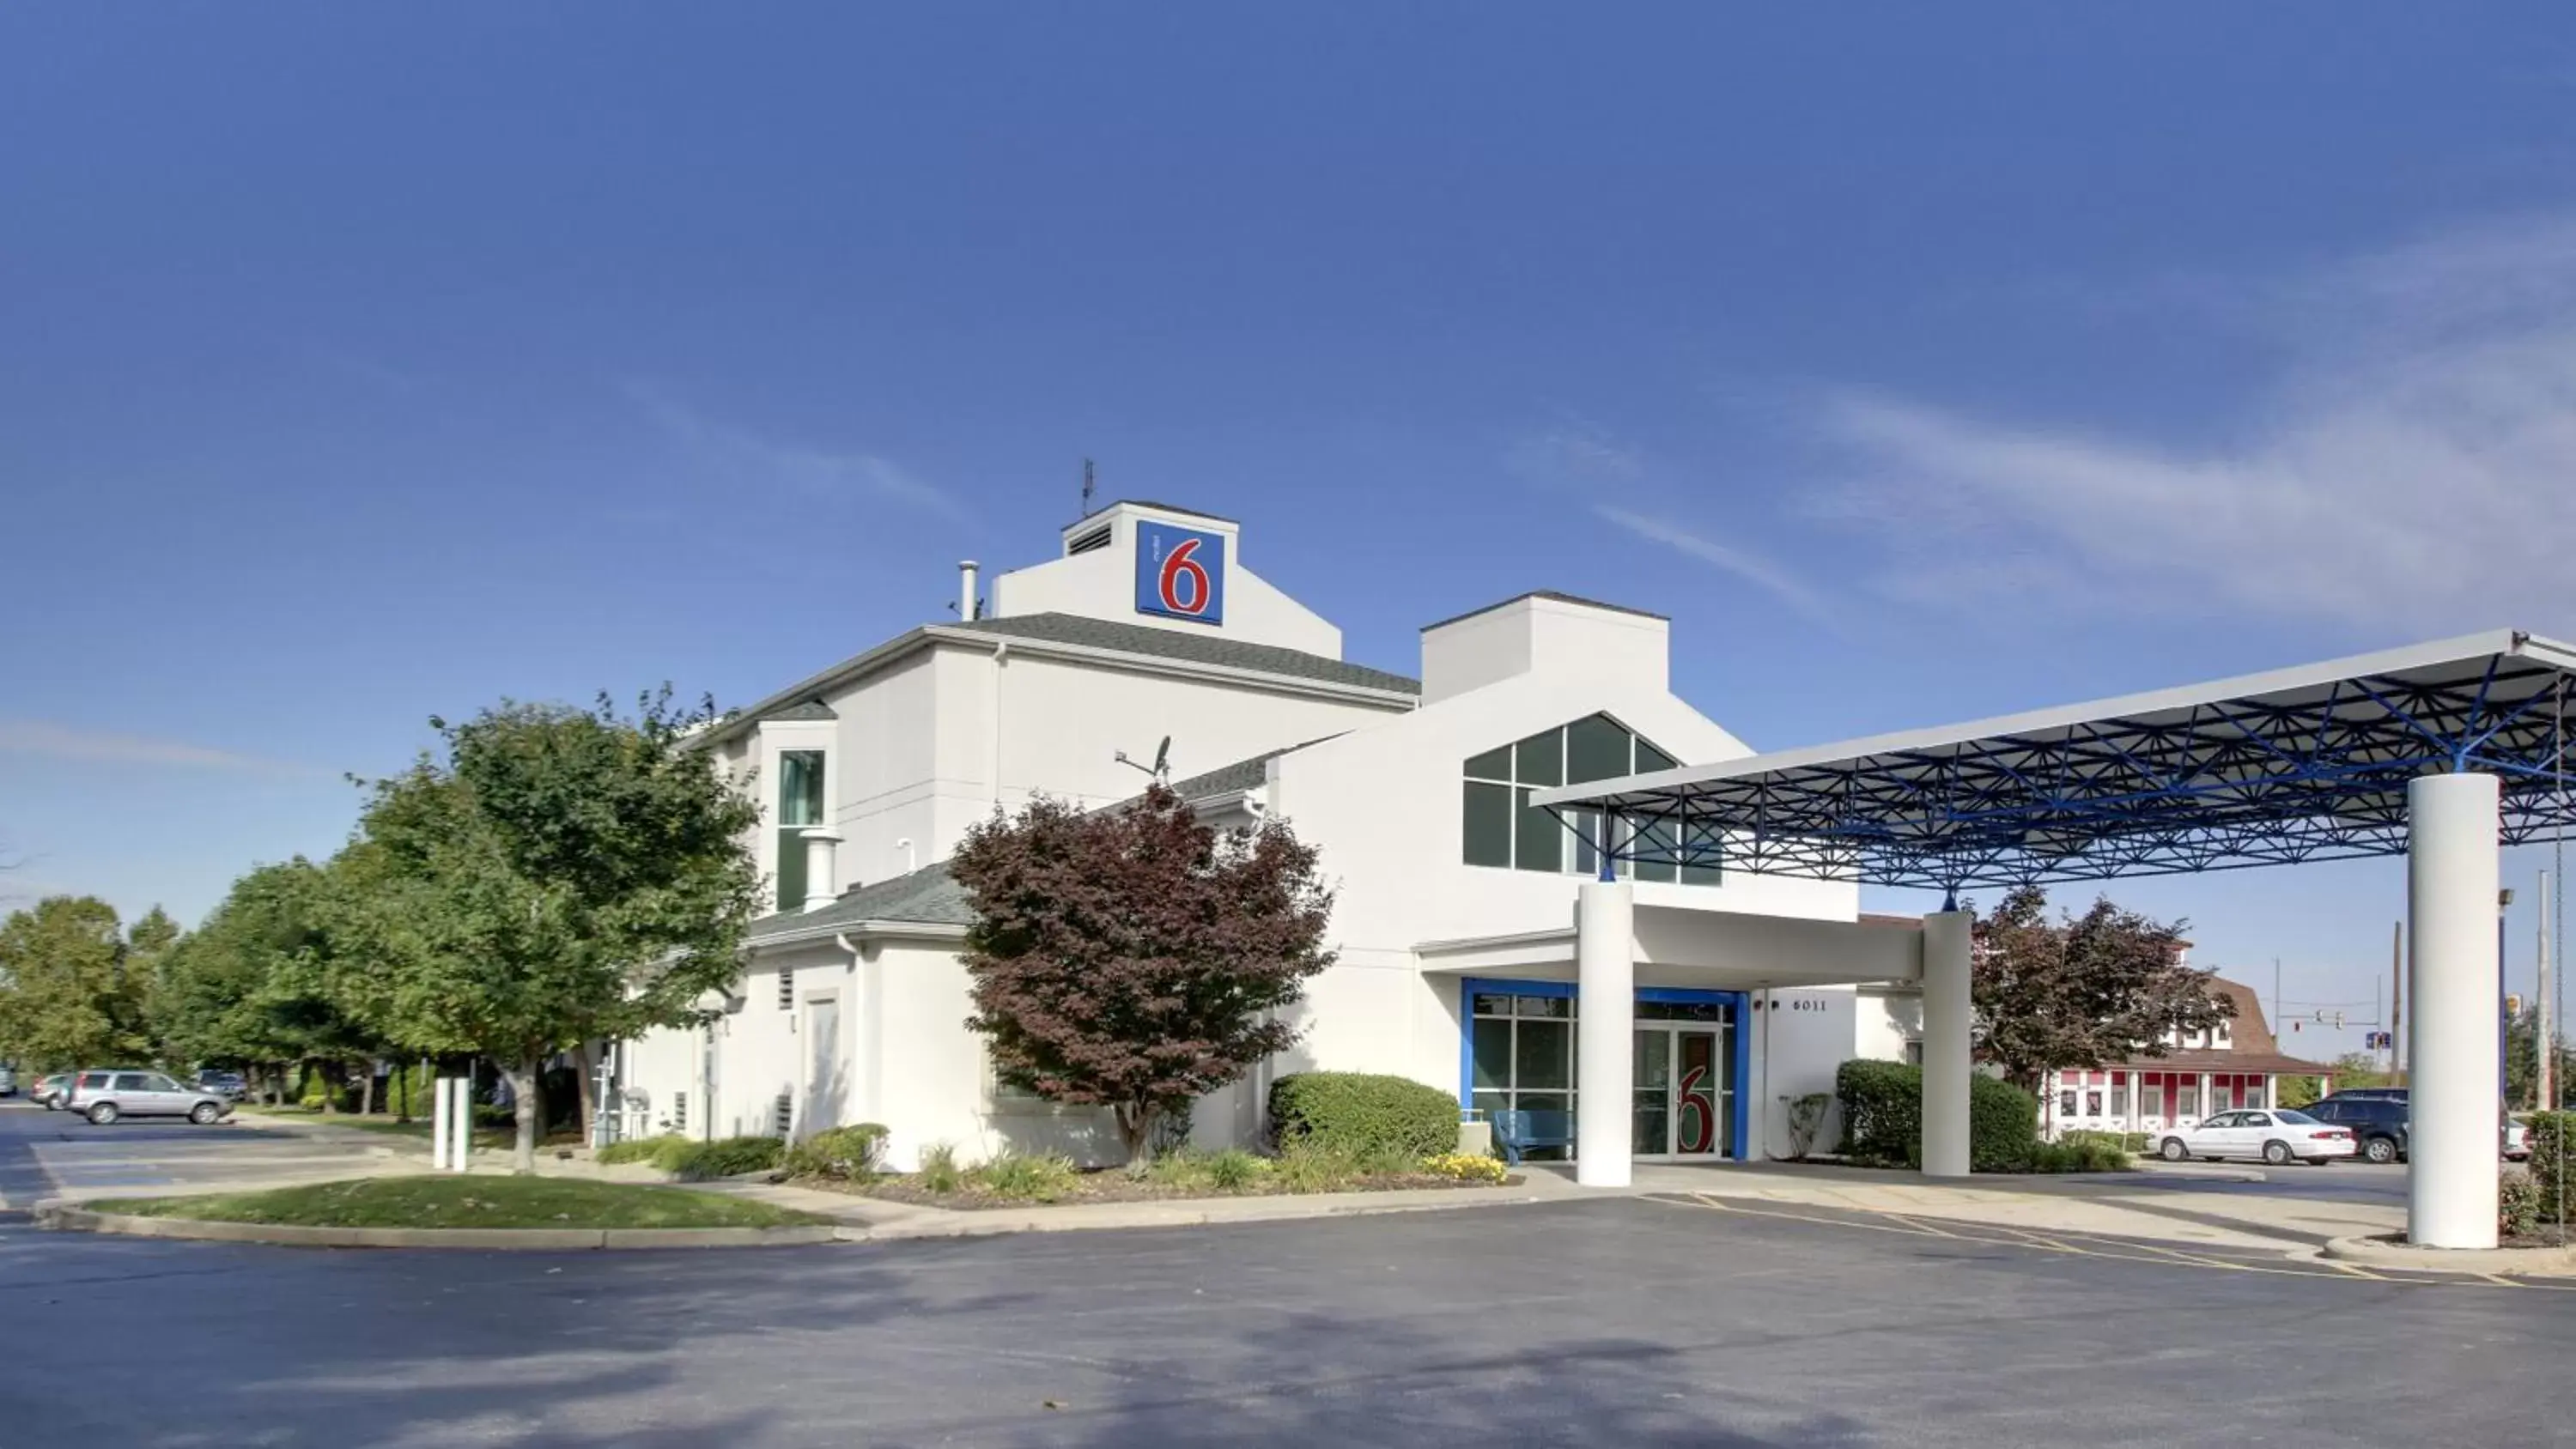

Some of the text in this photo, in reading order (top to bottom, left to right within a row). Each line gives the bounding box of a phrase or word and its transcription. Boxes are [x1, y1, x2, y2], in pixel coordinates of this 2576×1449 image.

[1158, 538, 1210, 615] 6
[1793, 999, 1826, 1012] 6011
[1676, 1064, 1714, 1154] 6
